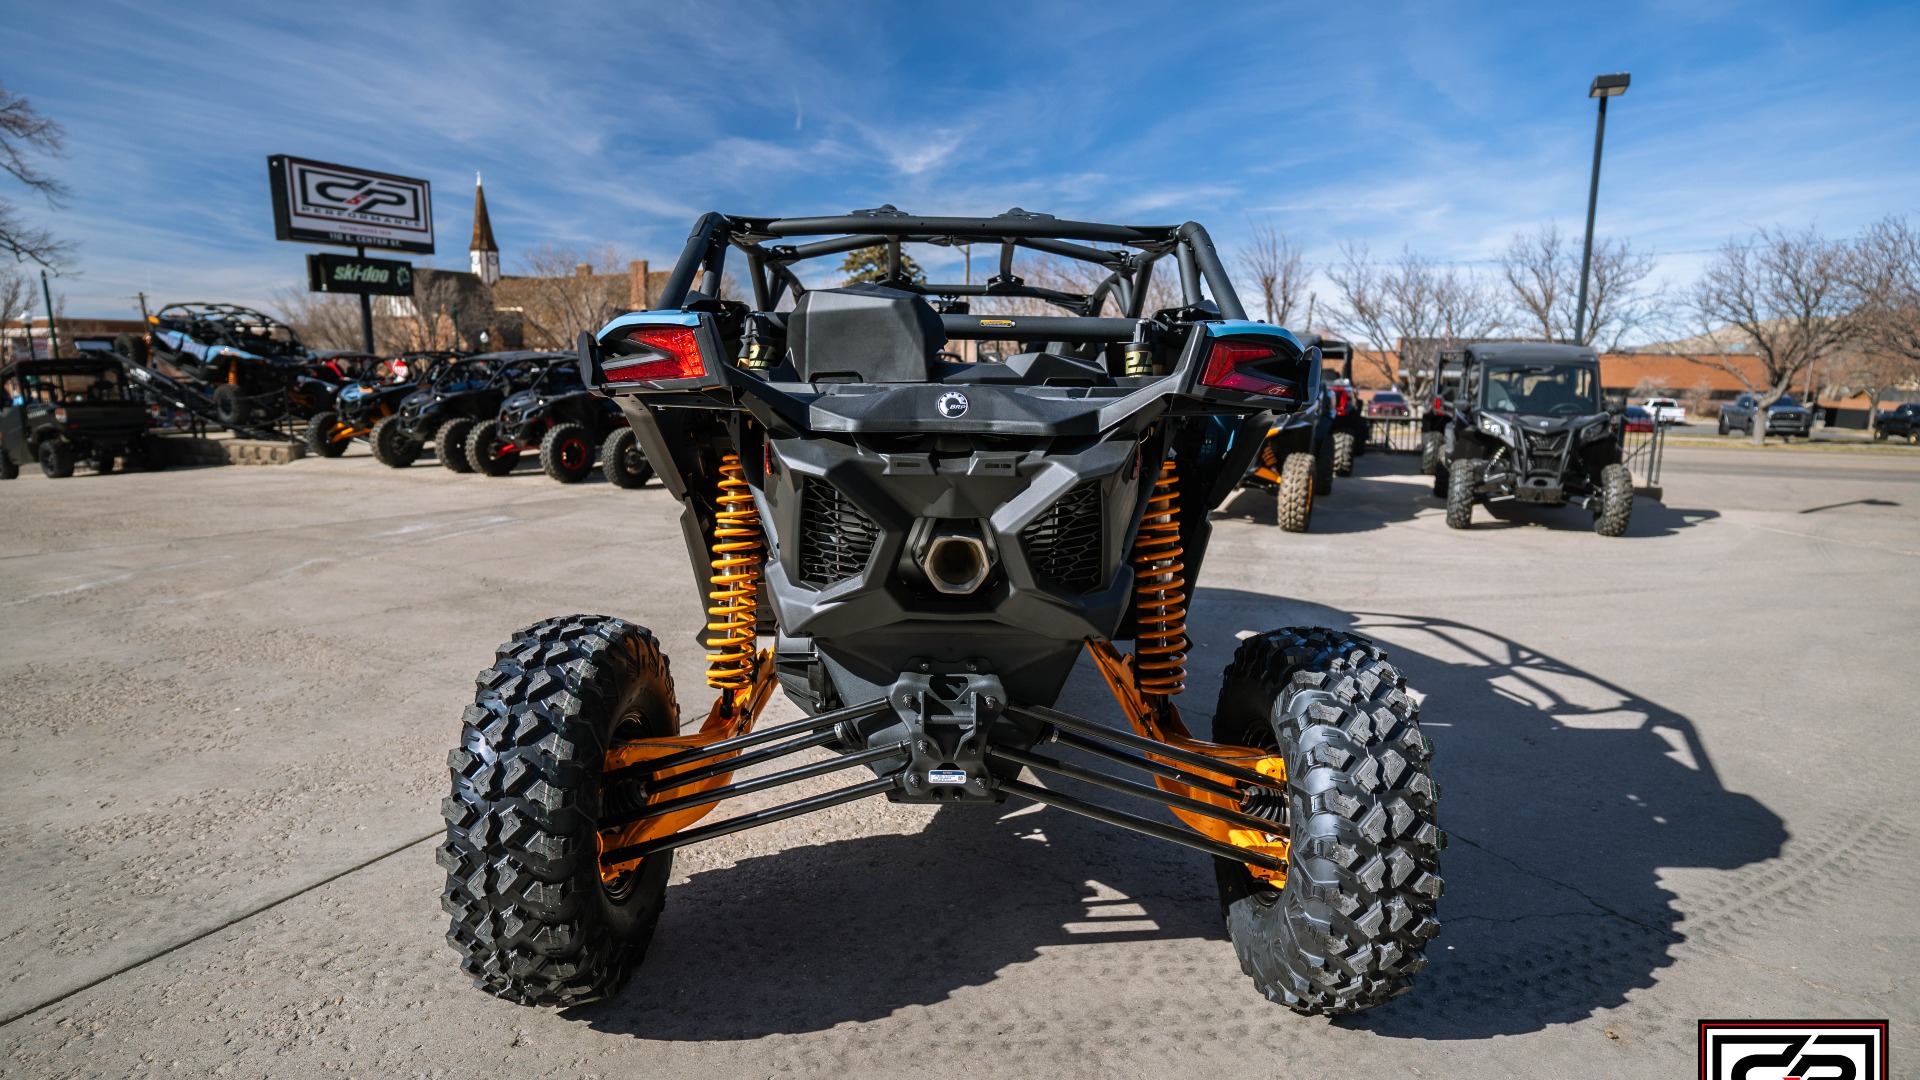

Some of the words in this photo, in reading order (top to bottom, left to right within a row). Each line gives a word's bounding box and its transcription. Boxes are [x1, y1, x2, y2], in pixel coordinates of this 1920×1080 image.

[301, 206, 421, 227] PERFORMANCE
[329, 232, 342, 241] 110
[345, 233, 354, 242] E.
[356, 235, 388, 245] CENTER
